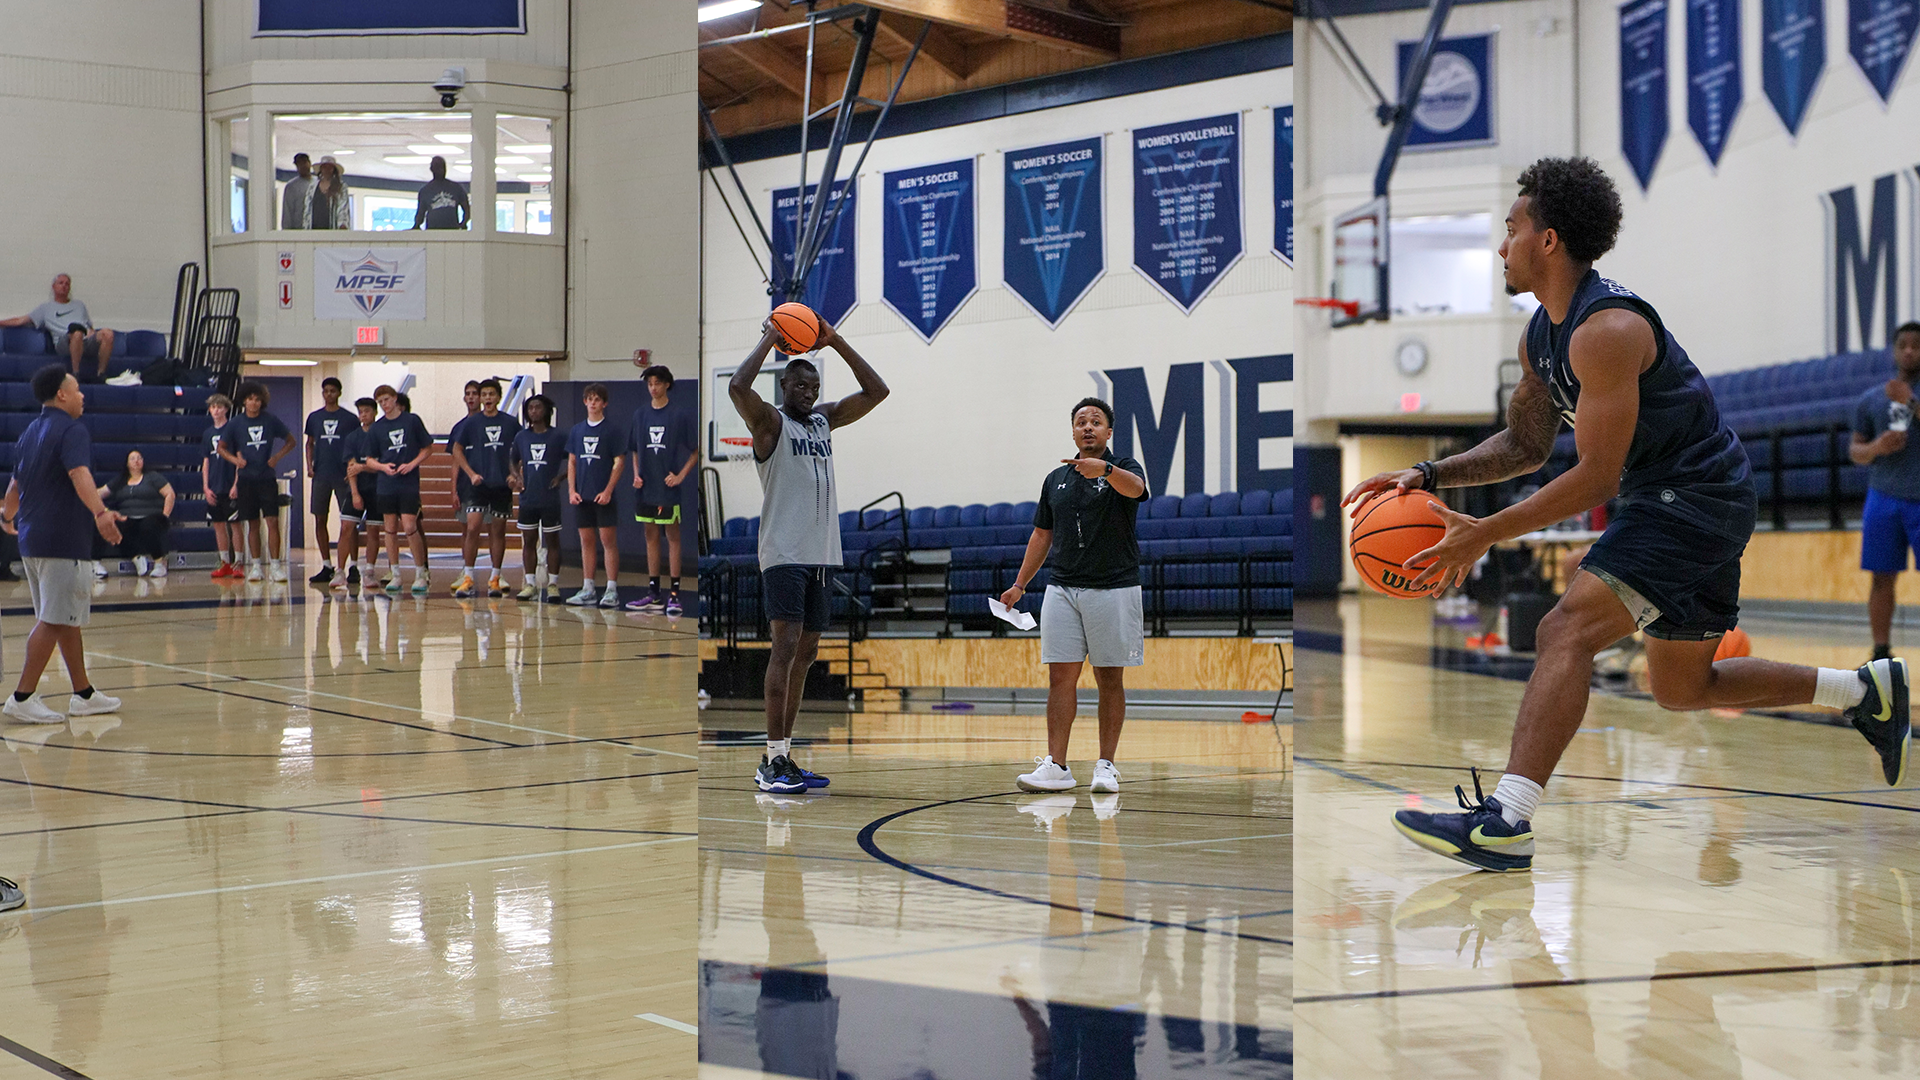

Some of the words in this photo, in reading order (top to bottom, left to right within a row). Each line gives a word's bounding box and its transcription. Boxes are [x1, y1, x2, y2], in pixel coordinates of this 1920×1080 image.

[1138, 133, 1180, 149] WOMEN'S
[1180, 125, 1235, 143] VOLLEYBALL
[1013, 155, 1056, 170] WOMEN'S
[1057, 149, 1092, 163] SOCCER
[1177, 150, 1196, 159] NCAA
[1158, 165, 1173, 173] West
[1174, 161, 1195, 172] Region
[1196, 158, 1230, 168] Champions
[898, 176, 924, 189] MEN'S
[925, 171, 959, 184] SOCCER
[1021, 174, 1052, 185] Conference
[1053, 169, 1085, 180] Champions
[1045, 183, 1059, 192] 2005
[1152, 187, 1186, 197] Conference
[1187, 181, 1222, 192] Champions
[899, 195, 928, 205] Conference
[928, 190, 959, 200] Champions
[1045, 192, 1059, 201] 2007
[921, 202, 935, 211] 2011
[1045, 202, 1059, 210] 2014
[1200, 202, 1215, 211] 2012
[921, 211, 935, 220] 2012
[1180, 215, 1195, 223] 2014
[1200, 211, 1215, 220] 2019
[1045, 225, 1060, 233] NAIA
[921, 230, 936, 239] 2019
[1020, 234, 1044, 245] National
[1045, 231, 1086, 242] Championship
[1035, 241, 1071, 252] Appearances
[1152, 241, 1178, 251] National
[1179, 235, 1224, 248] Championship
[1045, 252, 1059, 261] 2014
[1168, 248, 1208, 258] Appearances
[898, 257, 922, 268] National
[922, 252, 960, 265] Championship
[1201, 255, 1216, 264] 2012
[912, 264, 946, 274] Appearances
[1160, 270, 1175, 279] 2013
[1181, 268, 1195, 277] 2014
[1201, 265, 1216, 274] 2019
[335, 275, 405, 289] MPSF
[922, 274, 935, 283] 2011
[922, 283, 936, 292] 2012
[922, 301, 936, 310] 2019
[357, 326, 379, 344] EXIT
[1101, 353, 1293, 498] ME
